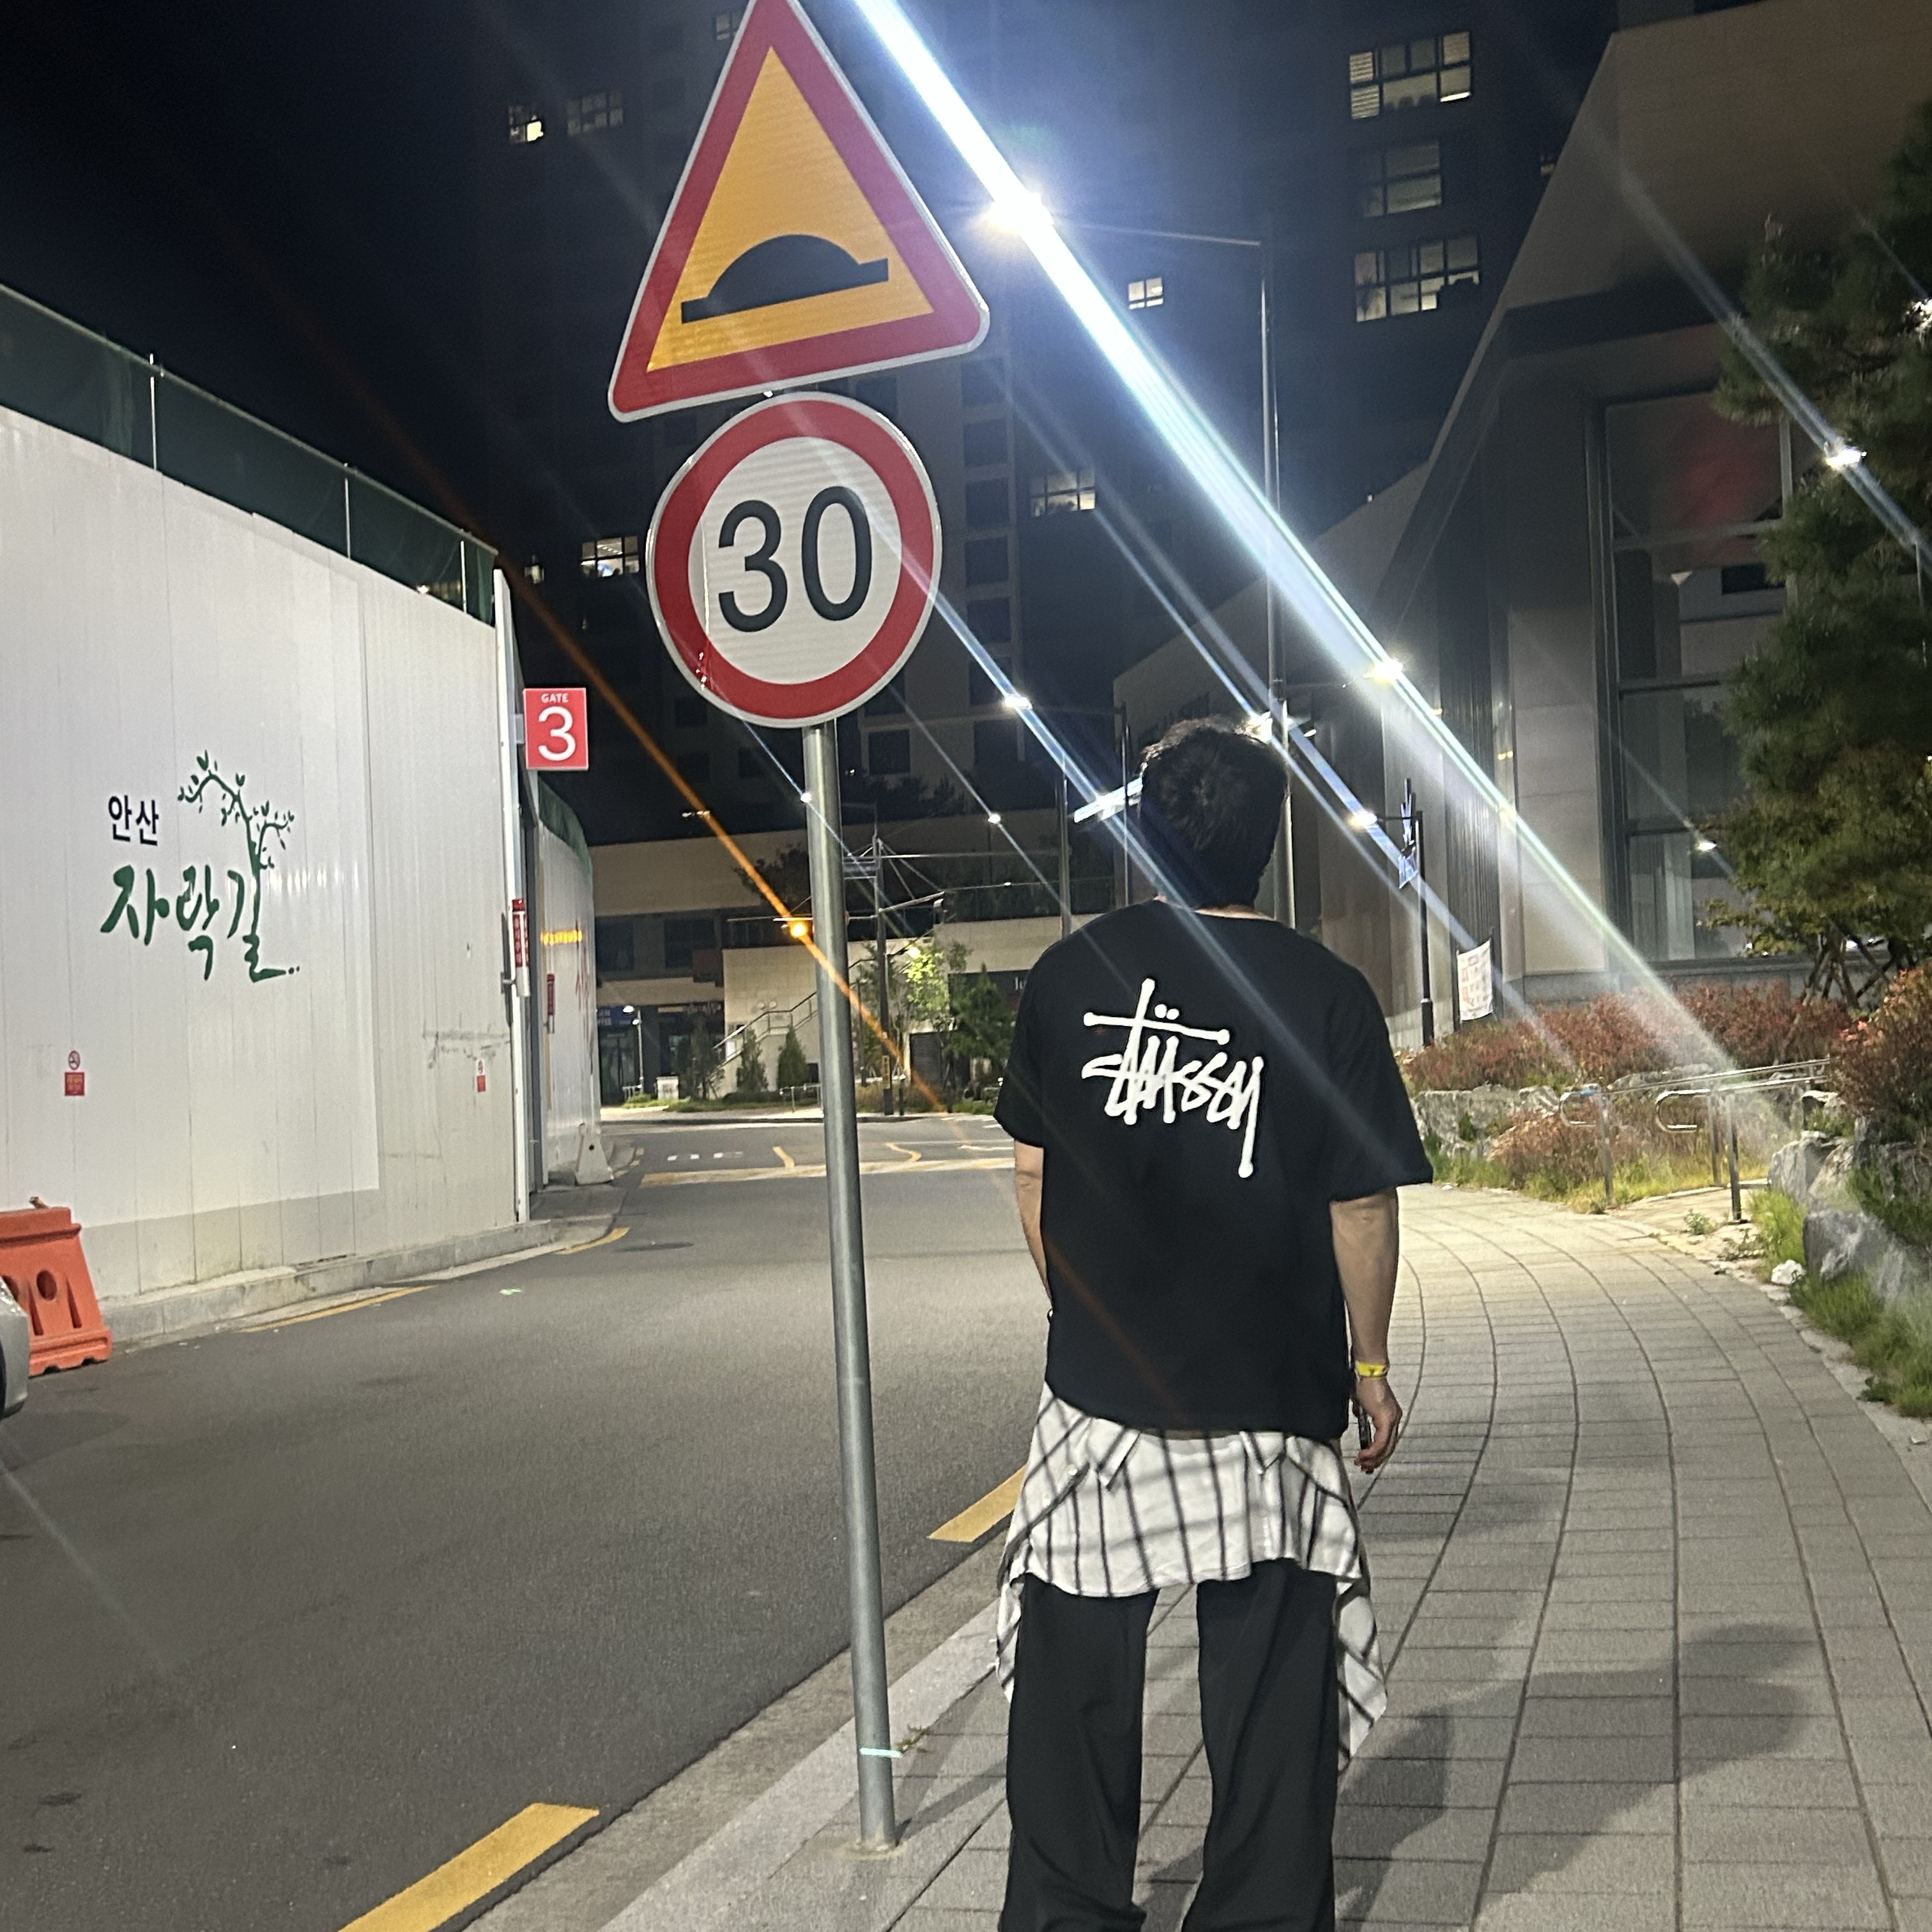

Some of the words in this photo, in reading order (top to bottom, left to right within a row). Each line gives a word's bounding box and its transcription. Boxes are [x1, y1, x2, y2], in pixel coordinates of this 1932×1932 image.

[718, 486, 873, 633] 30
[541, 693, 569, 703] GATE
[538, 706, 576, 761] 3
[108, 795, 159, 846] 안산
[100, 864, 286, 983] 자락길
